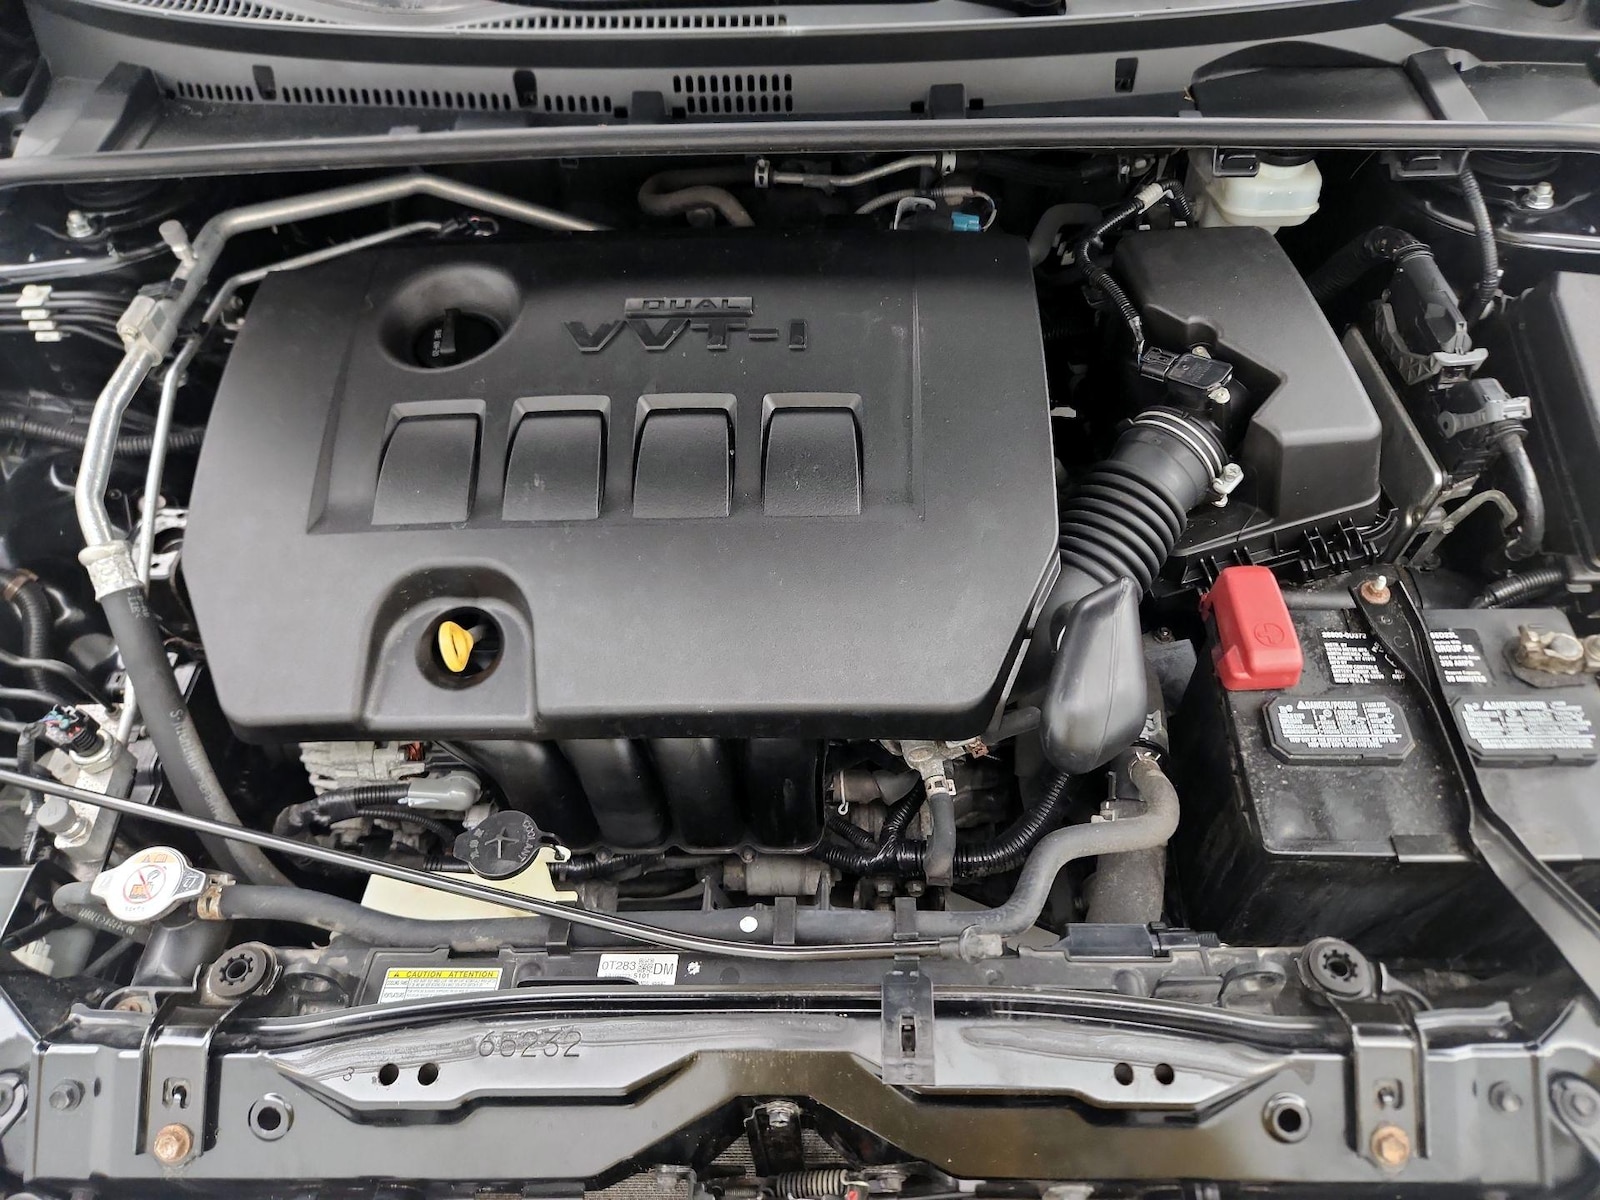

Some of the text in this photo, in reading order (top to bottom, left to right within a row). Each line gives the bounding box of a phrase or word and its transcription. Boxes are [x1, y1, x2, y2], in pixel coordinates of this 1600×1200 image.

[641, 298, 742, 311] DUAL
[1434, 644, 1462, 653] GROUP
[1455, 675, 1488, 683] MINUTES
[518, 818, 536, 862] COOLANT
[406, 970, 494, 978] CAUTION ATTENTION
[653, 962, 675, 975] DM
